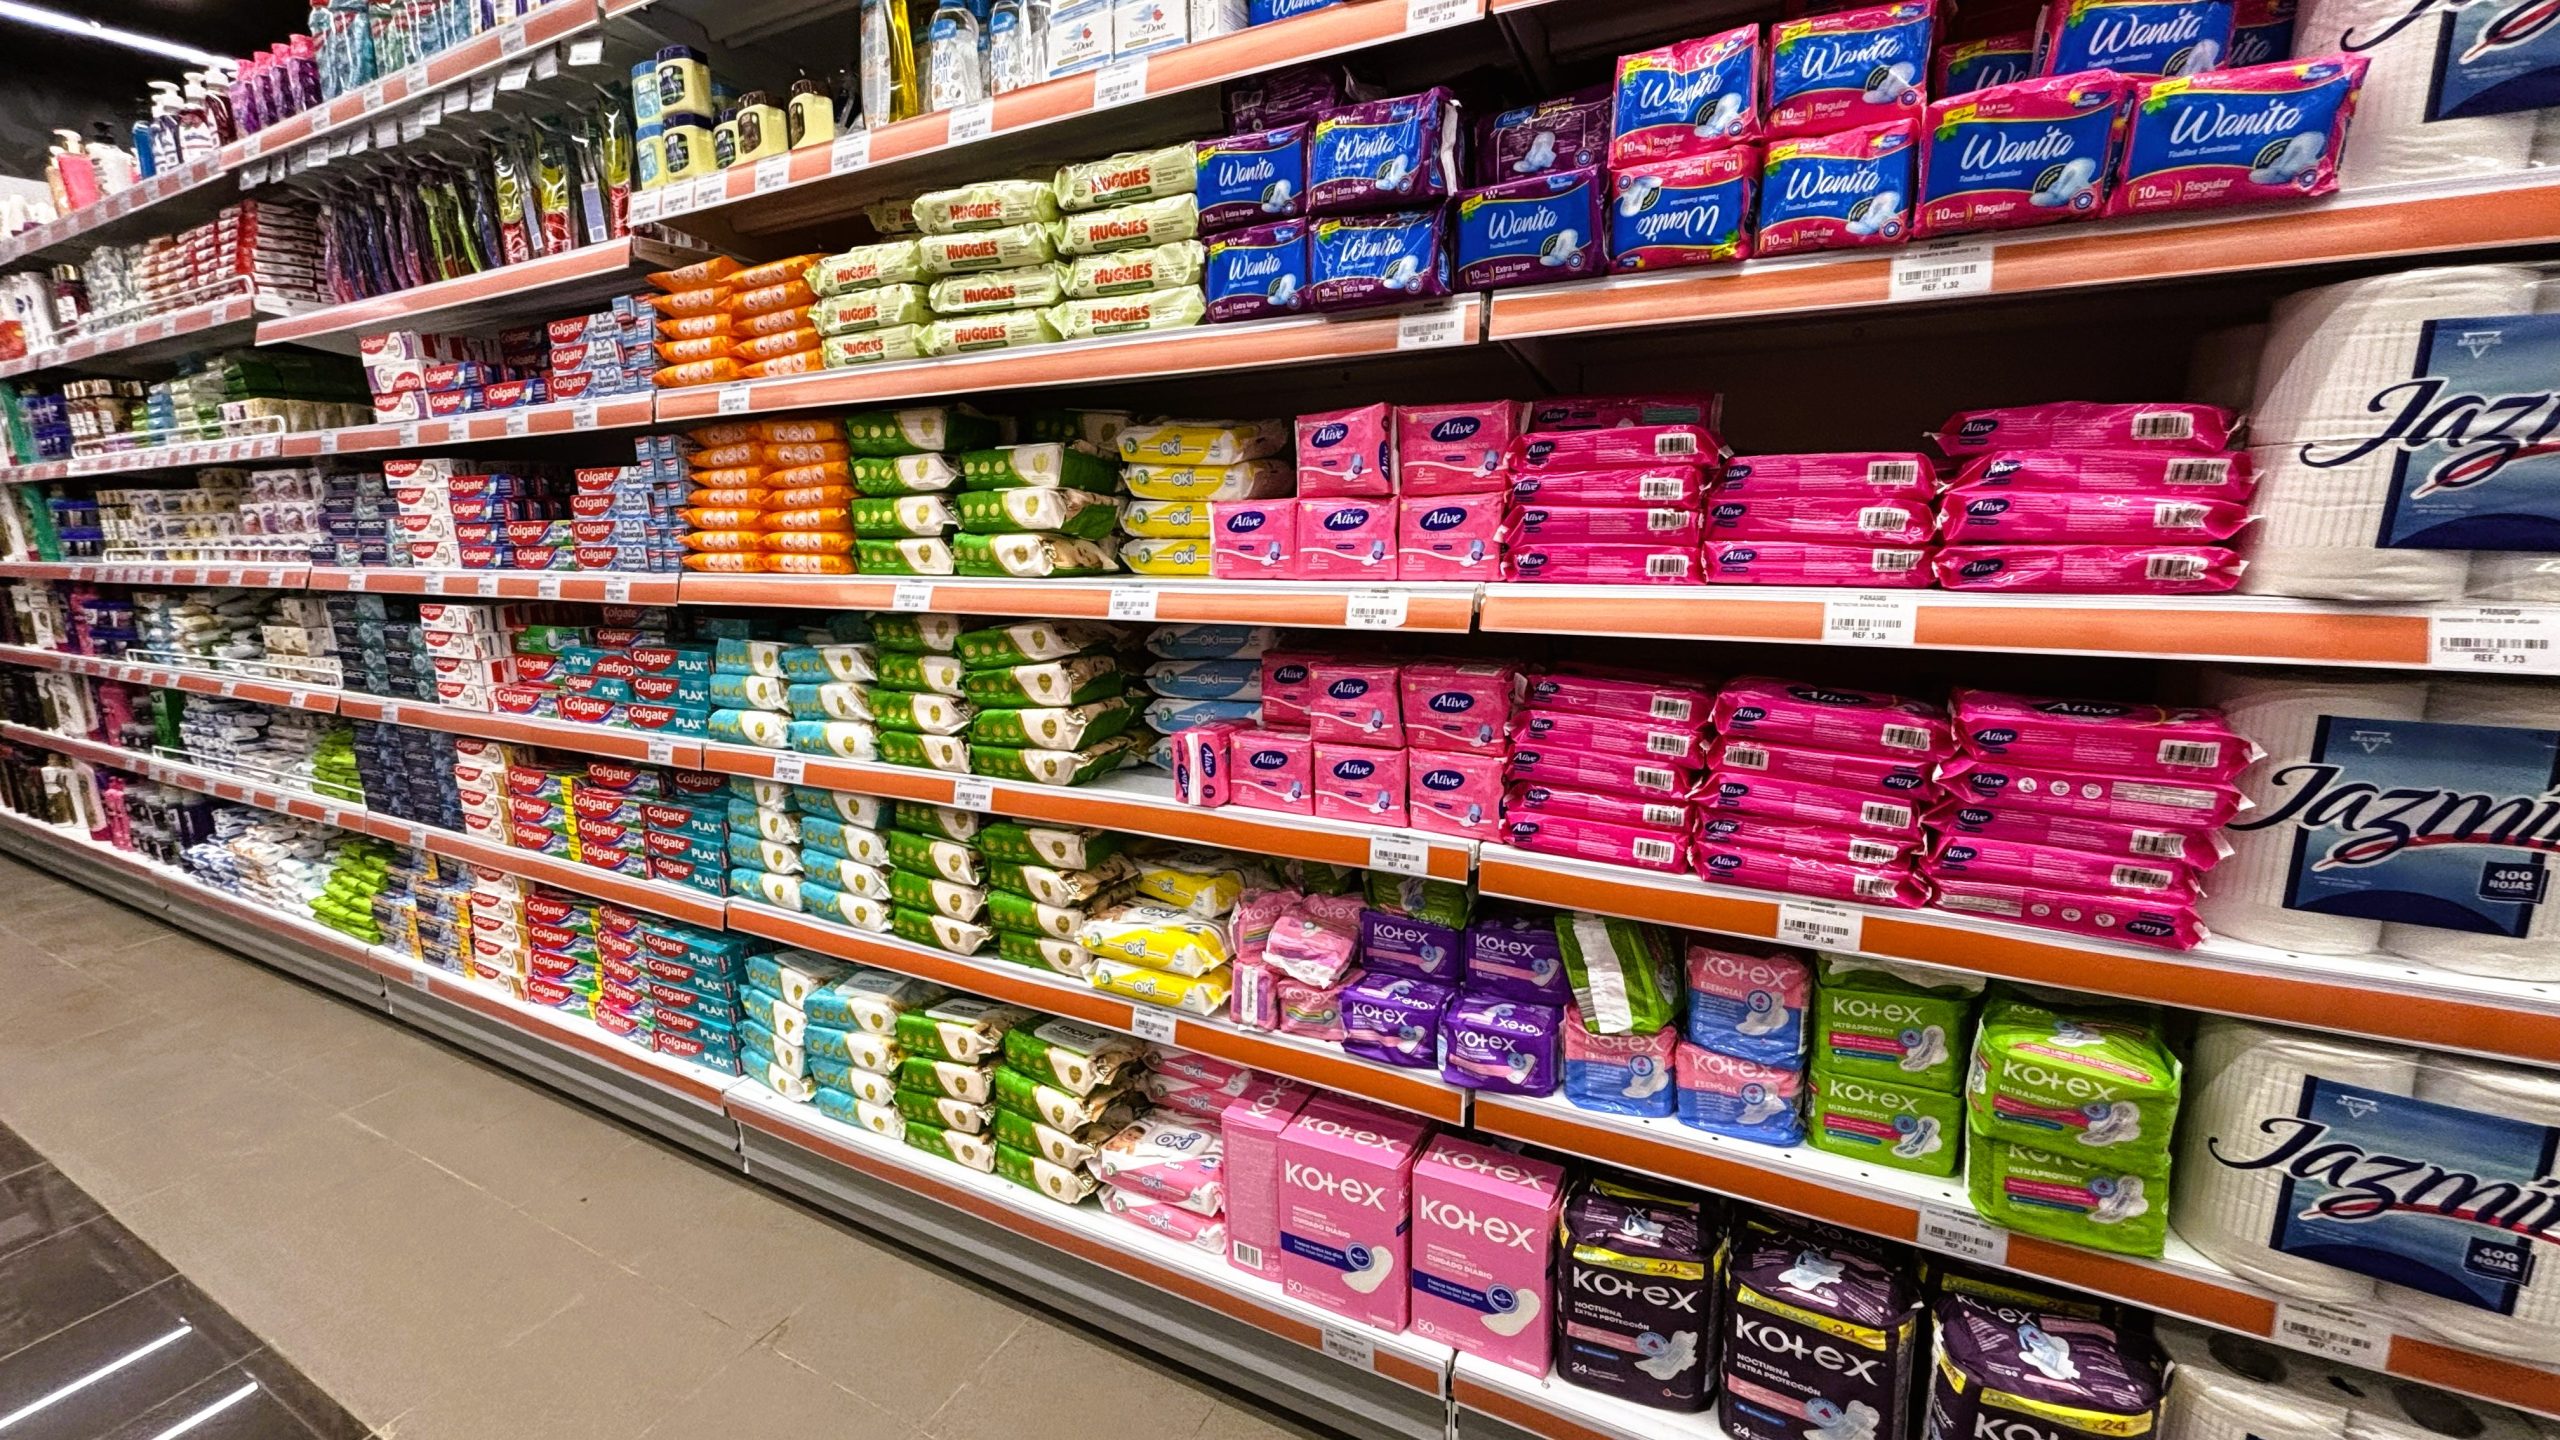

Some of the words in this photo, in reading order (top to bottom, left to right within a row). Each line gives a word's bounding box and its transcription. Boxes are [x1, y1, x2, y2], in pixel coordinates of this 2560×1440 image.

[2089, 12, 2201, 57] Wanita
[1802, 33, 1900, 78] Wanita
[1640, 72, 1723, 109] Wanita
[1815, 100, 1851, 113] Regular
[2170, 98, 2305, 144] Wanita
[1335, 131, 1395, 162] Wanita
[1654, 134, 1684, 146] Regular
[1961, 126, 2075, 171] Wanita
[1220, 157, 1274, 187] Wanita
[1787, 161, 1880, 201] Wanita
[2185, 177, 2233, 192] Regular
[950, 202, 1001, 220] HUGGIES
[1974, 201, 2015, 216] Regular
[1089, 220, 1148, 240] HUGGIES
[1489, 206, 1557, 240] Wanita
[1636, 206, 1719, 242] Wanita
[1801, 228, 1834, 240] Regular
[946, 242, 998, 259] HUGGIES
[1341, 232, 1402, 263] Wanita
[1094, 263, 1153, 284] HUGGIES
[1229, 253, 1281, 280] Wanita
[963, 286, 1015, 302] HUGGIES
[1091, 307, 1151, 325] HUGGIES
[550, 321, 583, 337] Colgate
[955, 326, 1006, 341] HUGGIES
[425, 369, 454, 383] Colgate
[553, 375, 586, 390] Colgate
[488, 386, 521, 399] Colgate
[1437, 417, 1474, 435] Alive
[1962, 421, 1994, 433] Alive
[1318, 427, 1344, 442] Alive
[1529, 443, 1551, 455] Alive
[386, 462, 417, 473] Colgate
[578, 471, 614, 483] Colgate
[450, 480, 484, 492] Colgate
[1514, 481, 1538, 492] Alive
[1971, 501, 2005, 513] Alive
[1234, 515, 1260, 528] Alive
[1332, 512, 1364, 525] Alive
[1428, 510, 1460, 525] Alive
[458, 528, 487, 538] Colgate
[508, 524, 543, 537] Colgate
[577, 525, 610, 536] Colgate
[1720, 549, 1753, 563] Alive
[517, 658, 549, 671] Colgate
[632, 650, 672, 664] Colgate
[2474, 654, 2497, 662] REF.
[2503, 655, 2525, 663] 1,73
[678, 660, 702, 672] PLAX
[1277, 668, 1304, 680] Alive
[1333, 681, 1365, 695] Alive
[498, 692, 533, 706] Colgate
[564, 698, 606, 715] Colgate
[1434, 694, 1468, 708] Alive
[629, 707, 669, 722] Colgate
[1733, 708, 1762, 720] Alive
[676, 718, 701, 729] PLAX
[1979, 731, 2013, 742] Alive
[1254, 753, 1284, 766] Alive
[1514, 752, 1538, 764] Alive
[589, 765, 631, 781] Colgate
[1338, 762, 1370, 776] Alive
[1427, 773, 1460, 787] Alive
[1974, 775, 2005, 786] Alive
[648, 808, 686, 824] Colgate
[692, 820, 718, 833] PLAX
[1513, 823, 1536, 834] Alive
[581, 846, 620, 862] Colgate
[1712, 856, 1739, 868] Alive
[2495, 871, 2533, 880] 400
[2488, 880, 2534, 890] HOJAS
[527, 902, 565, 917] Colgate
[646, 935, 682, 952] Colgate
[690, 953, 714, 965] PLAX
[530, 983, 565, 999] Colgate
[1701, 982, 1743, 997] ESENCIAL
[1832, 1021, 1894, 1034] ULTRAPROTECT
[659, 1035, 698, 1051] Colgate
[704, 1055, 729, 1068] PLAX
[1828, 1103, 1889, 1120] ULTRAPROTECT
[1293, 1216, 1324, 1230] CUIDADO
[1325, 1227, 1351, 1238] DIARIO
[1427, 1255, 1463, 1273] CUIDADO
[1465, 1265, 1493, 1280] DIARIO
[1287, 1279, 1302, 1293] 50
[1574, 1301, 1622, 1318] NOCTURNA
[1417, 1319, 1435, 1334] 50
[1574, 1308, 1598, 1321] EXTRA
[1599, 1313, 1650, 1331] PROTECCIÓN
[1571, 1362, 1588, 1375] 24
[1737, 1352, 1790, 1378] NOCTURNA
[1736, 1362, 1763, 1377] EXTRA
[1765, 1369, 1821, 1397] PROTECCIÓN
[1733, 1422, 1750, 1438] 24
